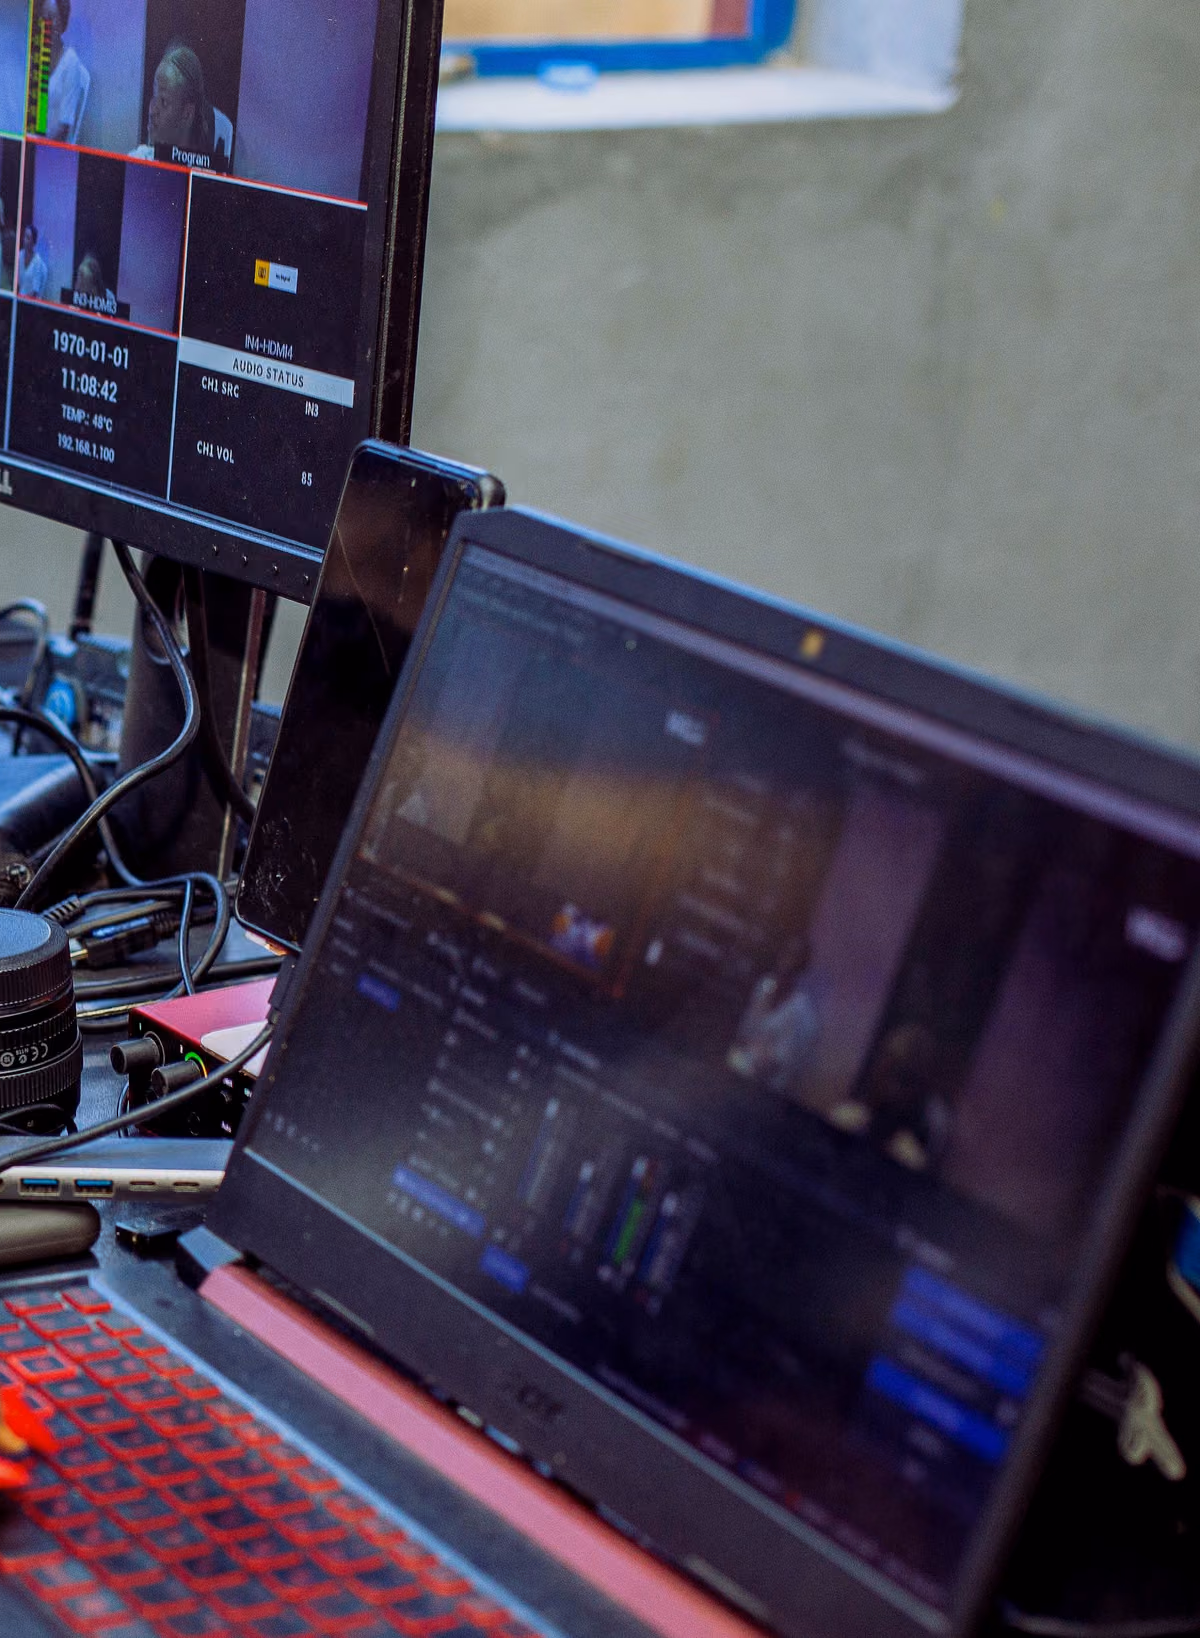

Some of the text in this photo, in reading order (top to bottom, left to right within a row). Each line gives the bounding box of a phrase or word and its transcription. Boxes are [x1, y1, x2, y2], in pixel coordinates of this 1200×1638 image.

[172, 145, 210, 168] Program
[53, 329, 129, 370] 1970-01-01
[245, 334, 294, 360] IN4-HDMI4
[61, 368, 118, 403] 11:08:42
[232, 358, 304, 388] AUDIO STATUS
[201, 376, 240, 398] CH1 SRC
[305, 401, 319, 418] IN3
[57, 432, 115, 463] 192.168.1.100
[197, 440, 234, 464] CH1 VOL
[301, 471, 313, 487] 85
